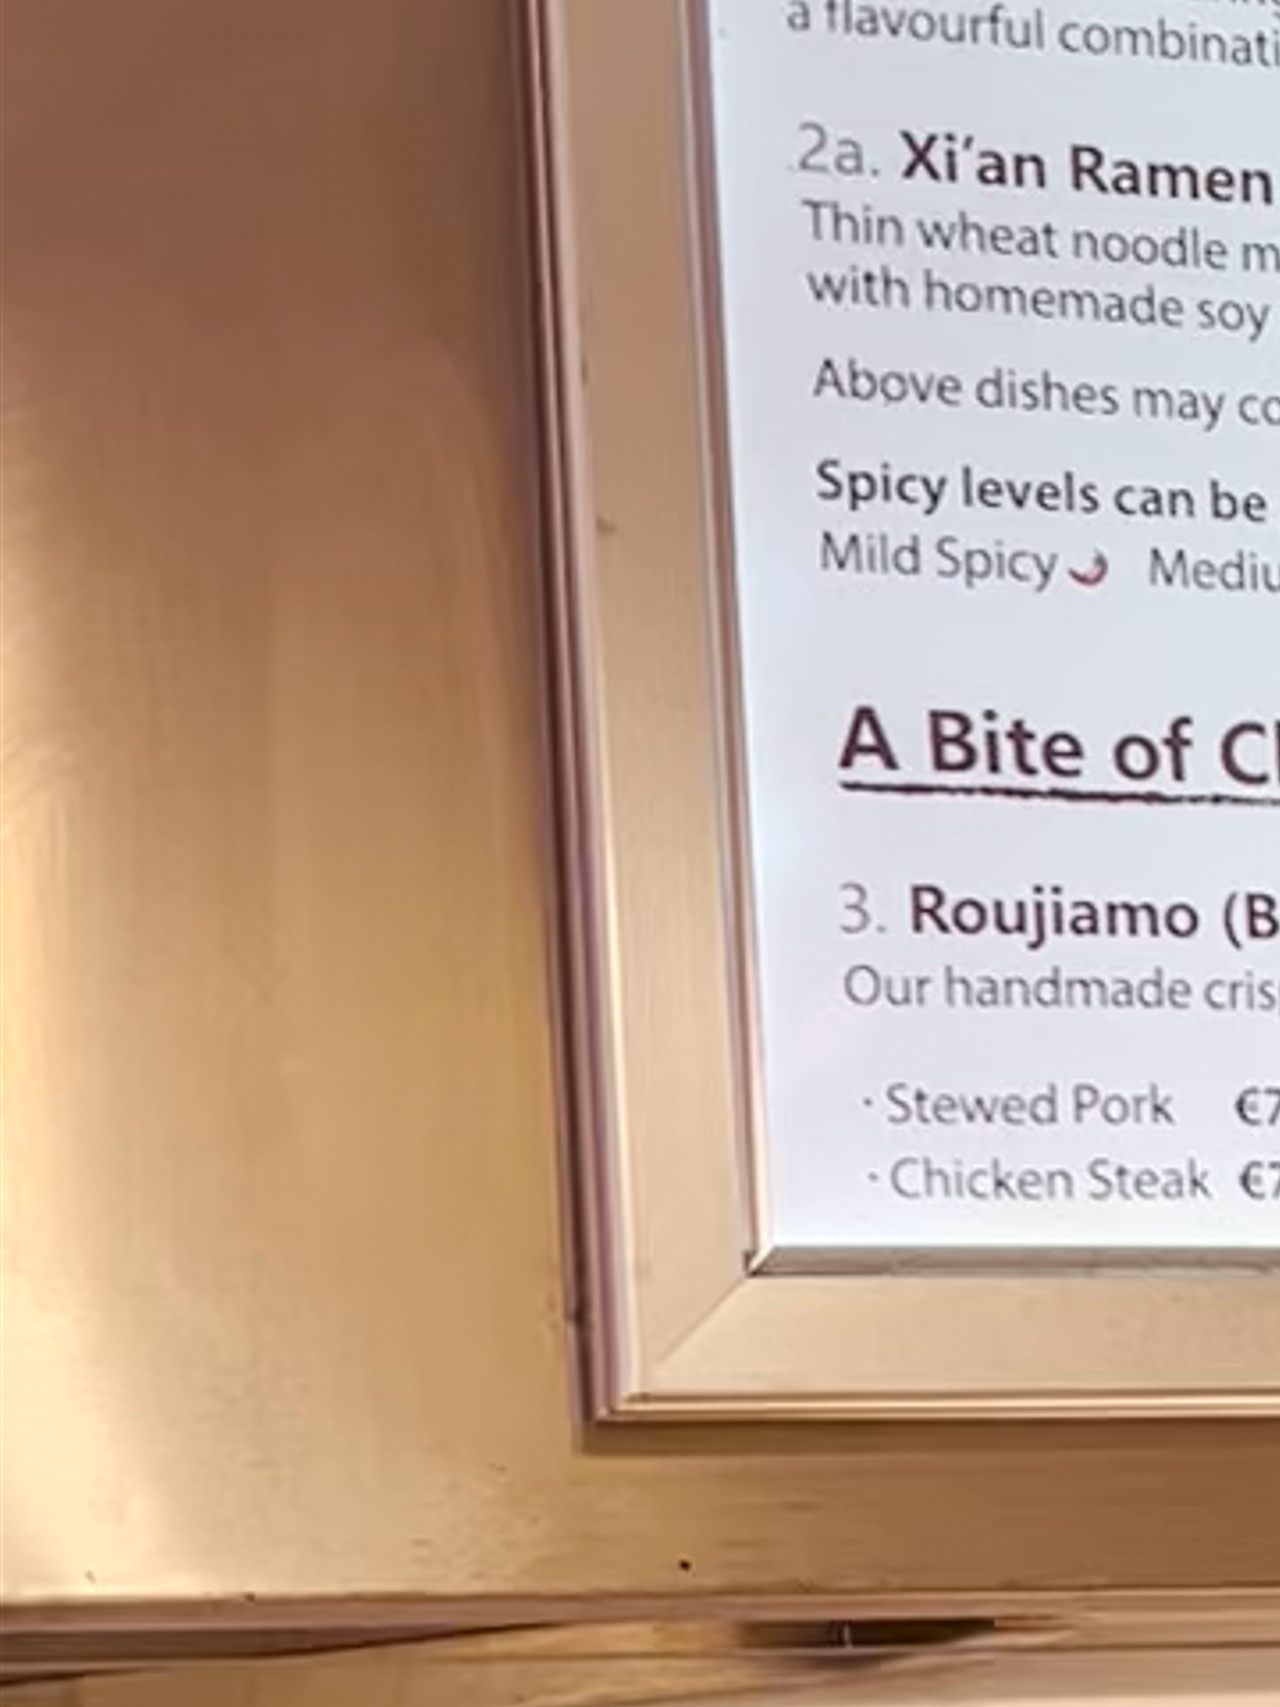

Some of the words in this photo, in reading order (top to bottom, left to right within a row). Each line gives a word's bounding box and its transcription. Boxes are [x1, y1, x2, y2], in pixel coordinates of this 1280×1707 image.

[798, 121, 880, 177] 2a.
[1069, 143, 1273, 206] Ramen
[815, 457, 948, 516] Spicy
[961, 464, 1101, 514] levels
[1112, 484, 1195, 518] can
[1209, 478, 1267, 523] be
[837, 704, 900, 770] A
[927, 708, 1084, 778] Bite
[1112, 715, 1193, 782] of
[840, 881, 886, 934] 3.
[910, 883, 1200, 951] Roujiamo
[885, 1082, 1058, 1126] Stewed
[1072, 1083, 1174, 1125] Pork
[890, 1156, 1074, 1200] Chicken
[1086, 1157, 1211, 1200] Steak
